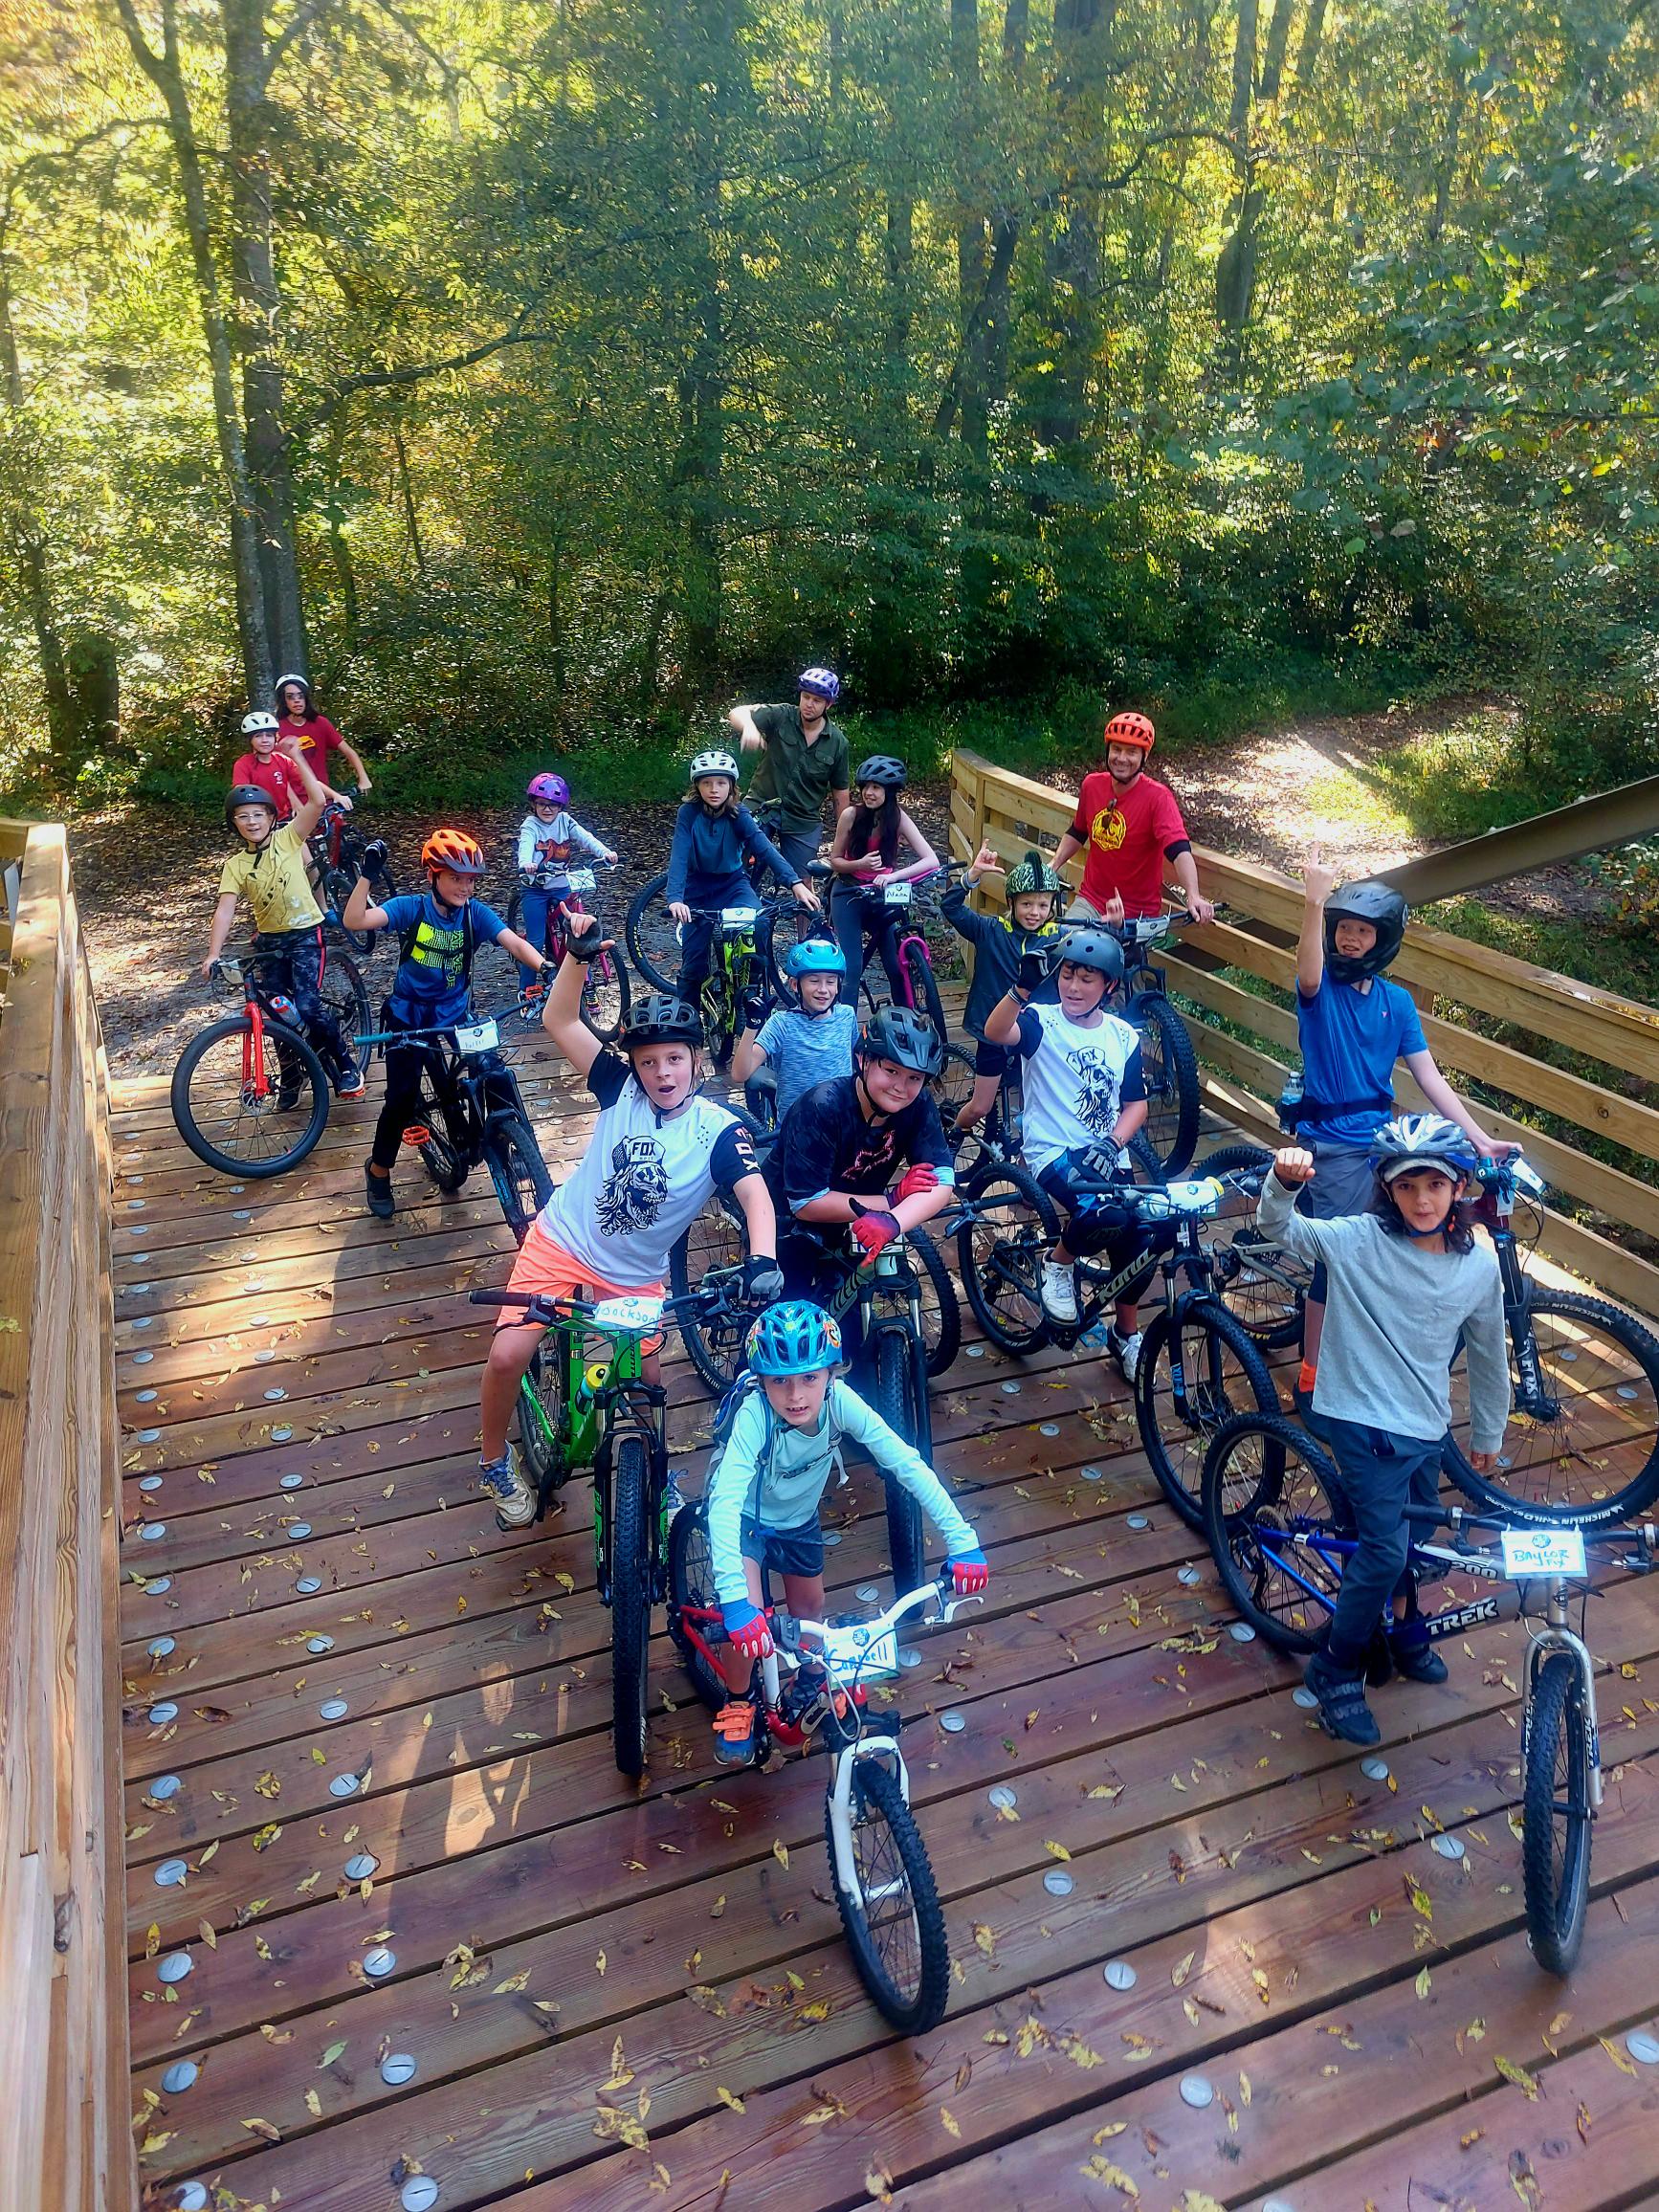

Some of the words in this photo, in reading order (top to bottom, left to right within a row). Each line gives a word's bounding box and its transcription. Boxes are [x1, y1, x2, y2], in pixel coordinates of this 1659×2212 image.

[631, 1141, 655, 1156] FOX
[735, 1126, 761, 1171] FOX
[1521, 1360, 1538, 1395] FOX
[1560, 1510, 1611, 1526] MICHELIN
[1450, 1560, 1497, 1580] 200
[1425, 1597, 1497, 1636] TREK
